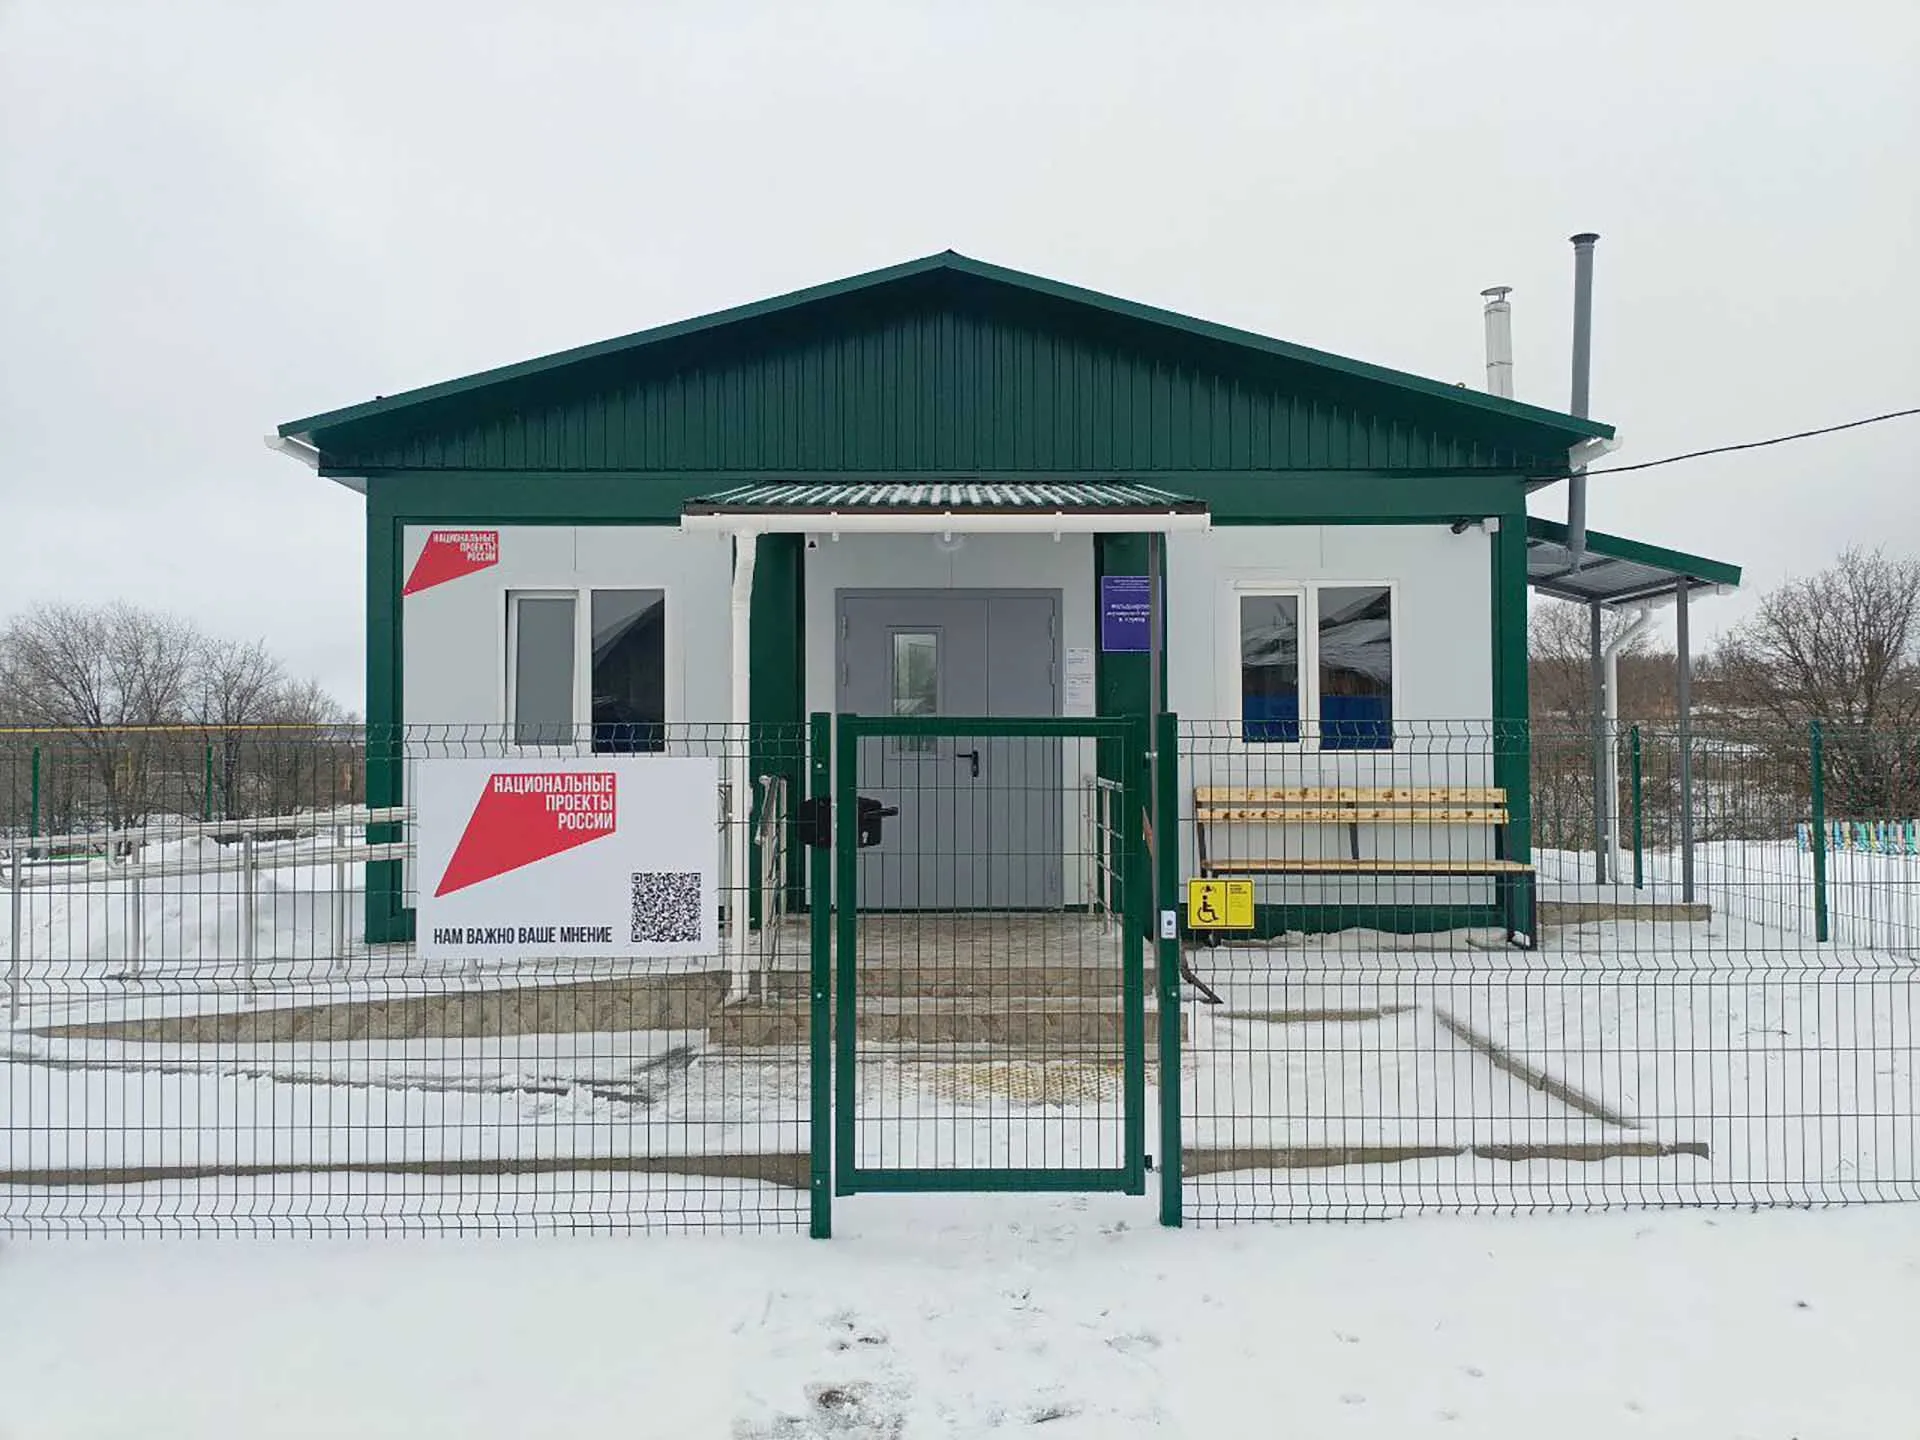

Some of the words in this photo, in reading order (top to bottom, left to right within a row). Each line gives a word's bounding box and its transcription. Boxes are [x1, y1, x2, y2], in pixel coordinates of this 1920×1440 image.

[494, 775, 613, 794] НАЦИОНАЛЬНЫЕ
[546, 794, 613, 811] ПРОЕКТЫ
[558, 813, 613, 830] РОССИИ
[434, 928, 463, 945] НАМ
[467, 927, 515, 944] ВАЖНО
[518, 927, 556, 943] ВАШЕ
[560, 926, 613, 943] МНЕНИЕ
